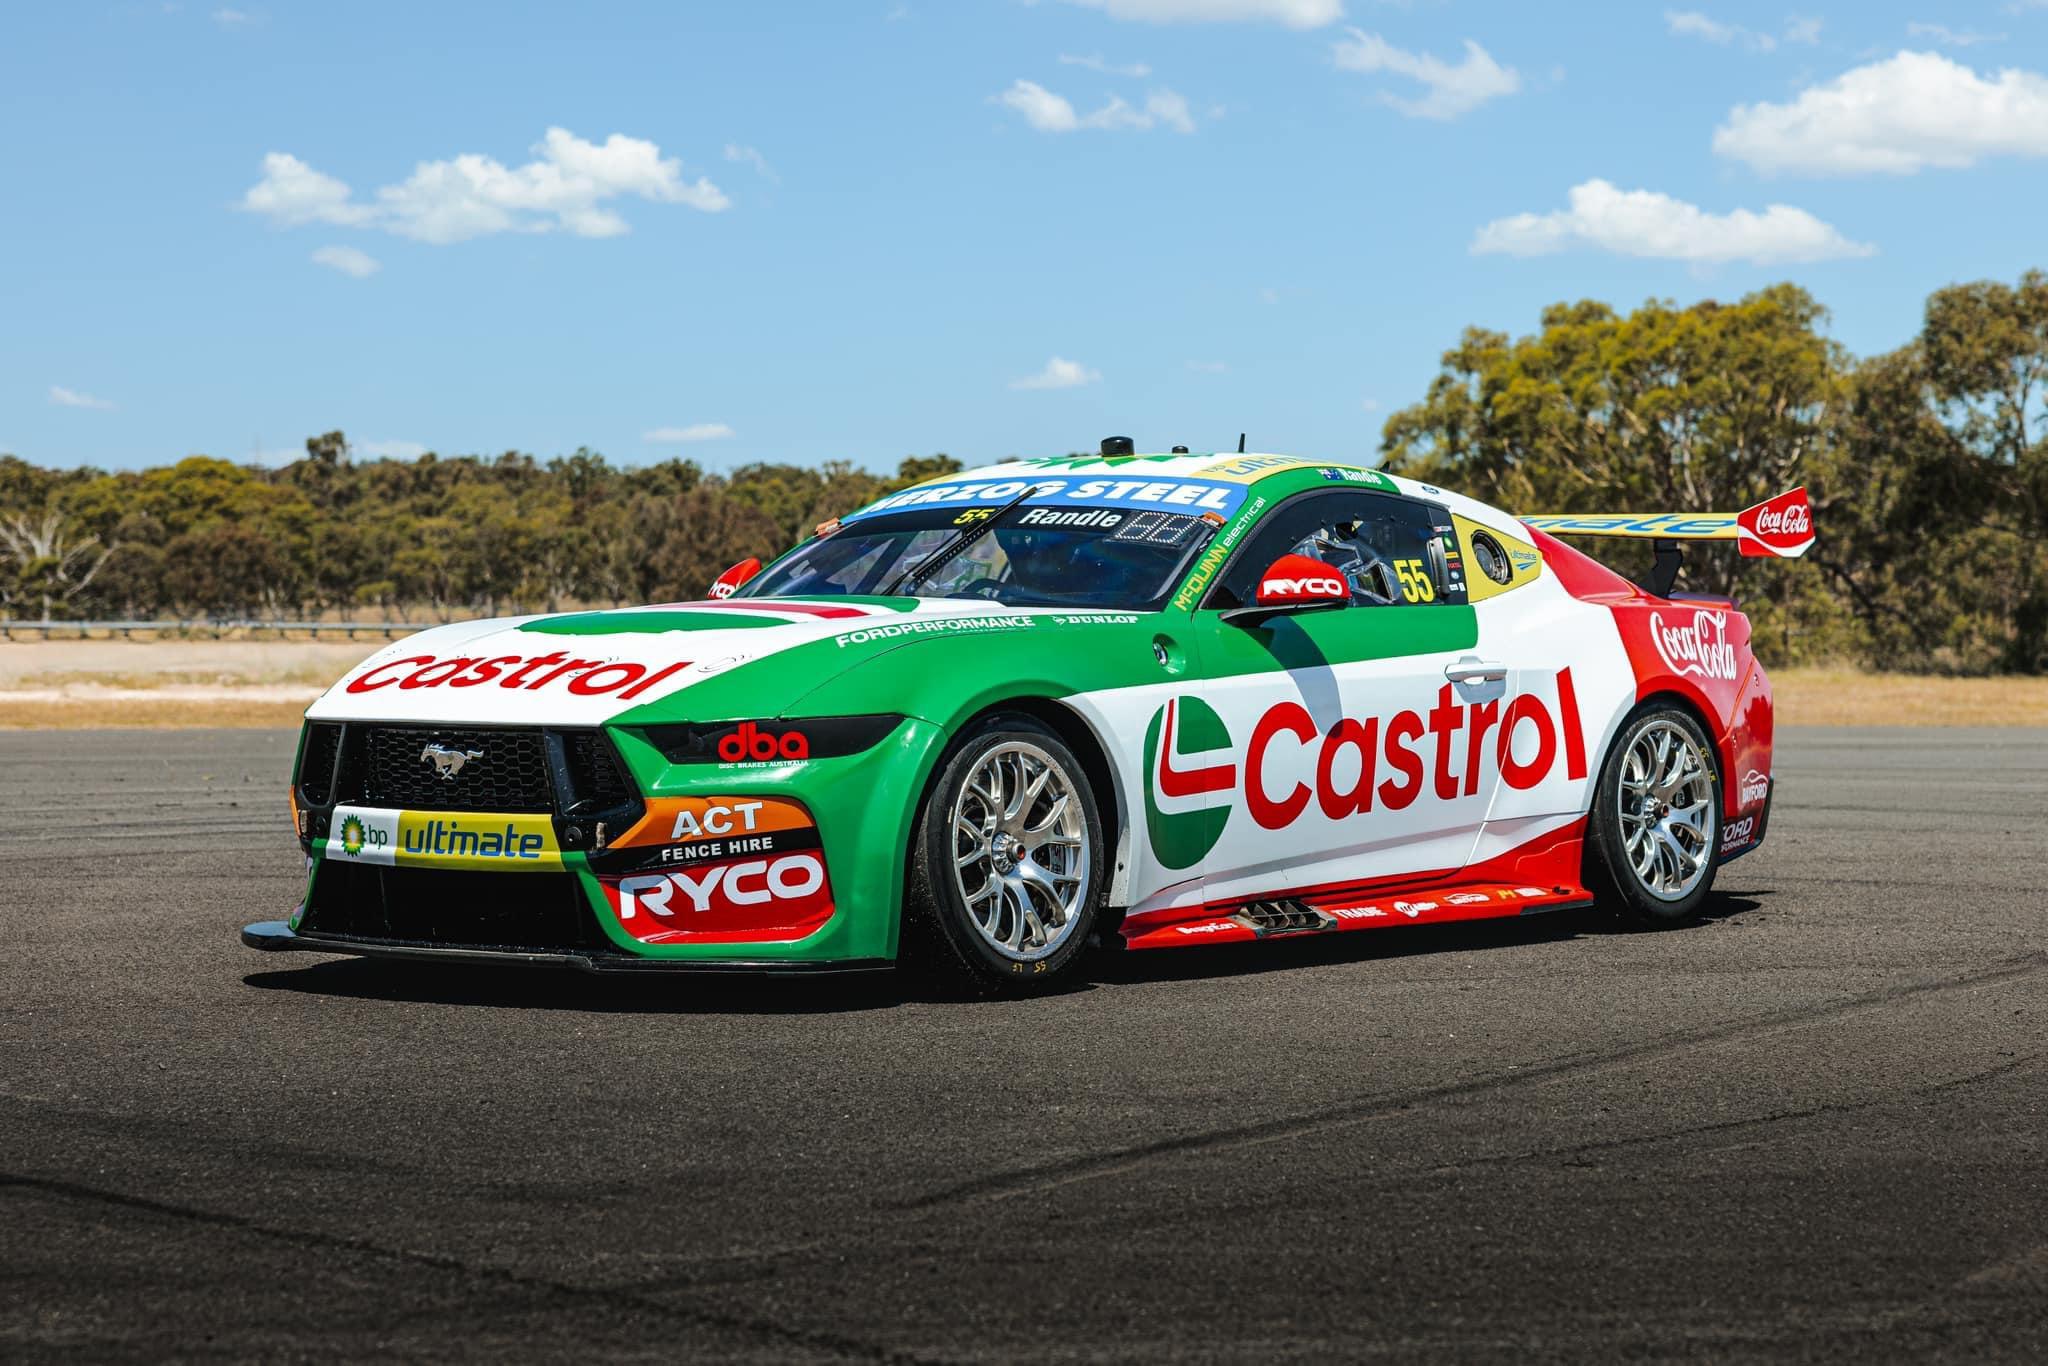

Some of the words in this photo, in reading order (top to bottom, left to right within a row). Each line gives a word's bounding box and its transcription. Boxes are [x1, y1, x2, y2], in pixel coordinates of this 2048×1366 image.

[863, 481, 1068, 514] HERZOG
[1067, 481, 1232, 510] STEEL
[953, 508, 996, 525] 55
[1018, 508, 1122, 528] Randle
[1223, 496, 1267, 547] electrical
[1263, 578, 1343, 597] RYCO
[1393, 559, 1436, 604] 55
[1066, 615, 1139, 625] DUNLOP
[345, 650, 693, 700] Castrol
[718, 721, 809, 762] dba
[1245, 665, 1587, 831] Castrol
[769, 760, 809, 768] AUSTRALIA
[671, 801, 763, 840] ACT
[1723, 816, 1753, 842] ORD
[368, 824, 388, 850] bp
[405, 820, 544, 859] ultimate
[661, 843, 722, 862] FENCE
[729, 836, 773, 854] HIRE
[619, 855, 824, 919] RYCO
